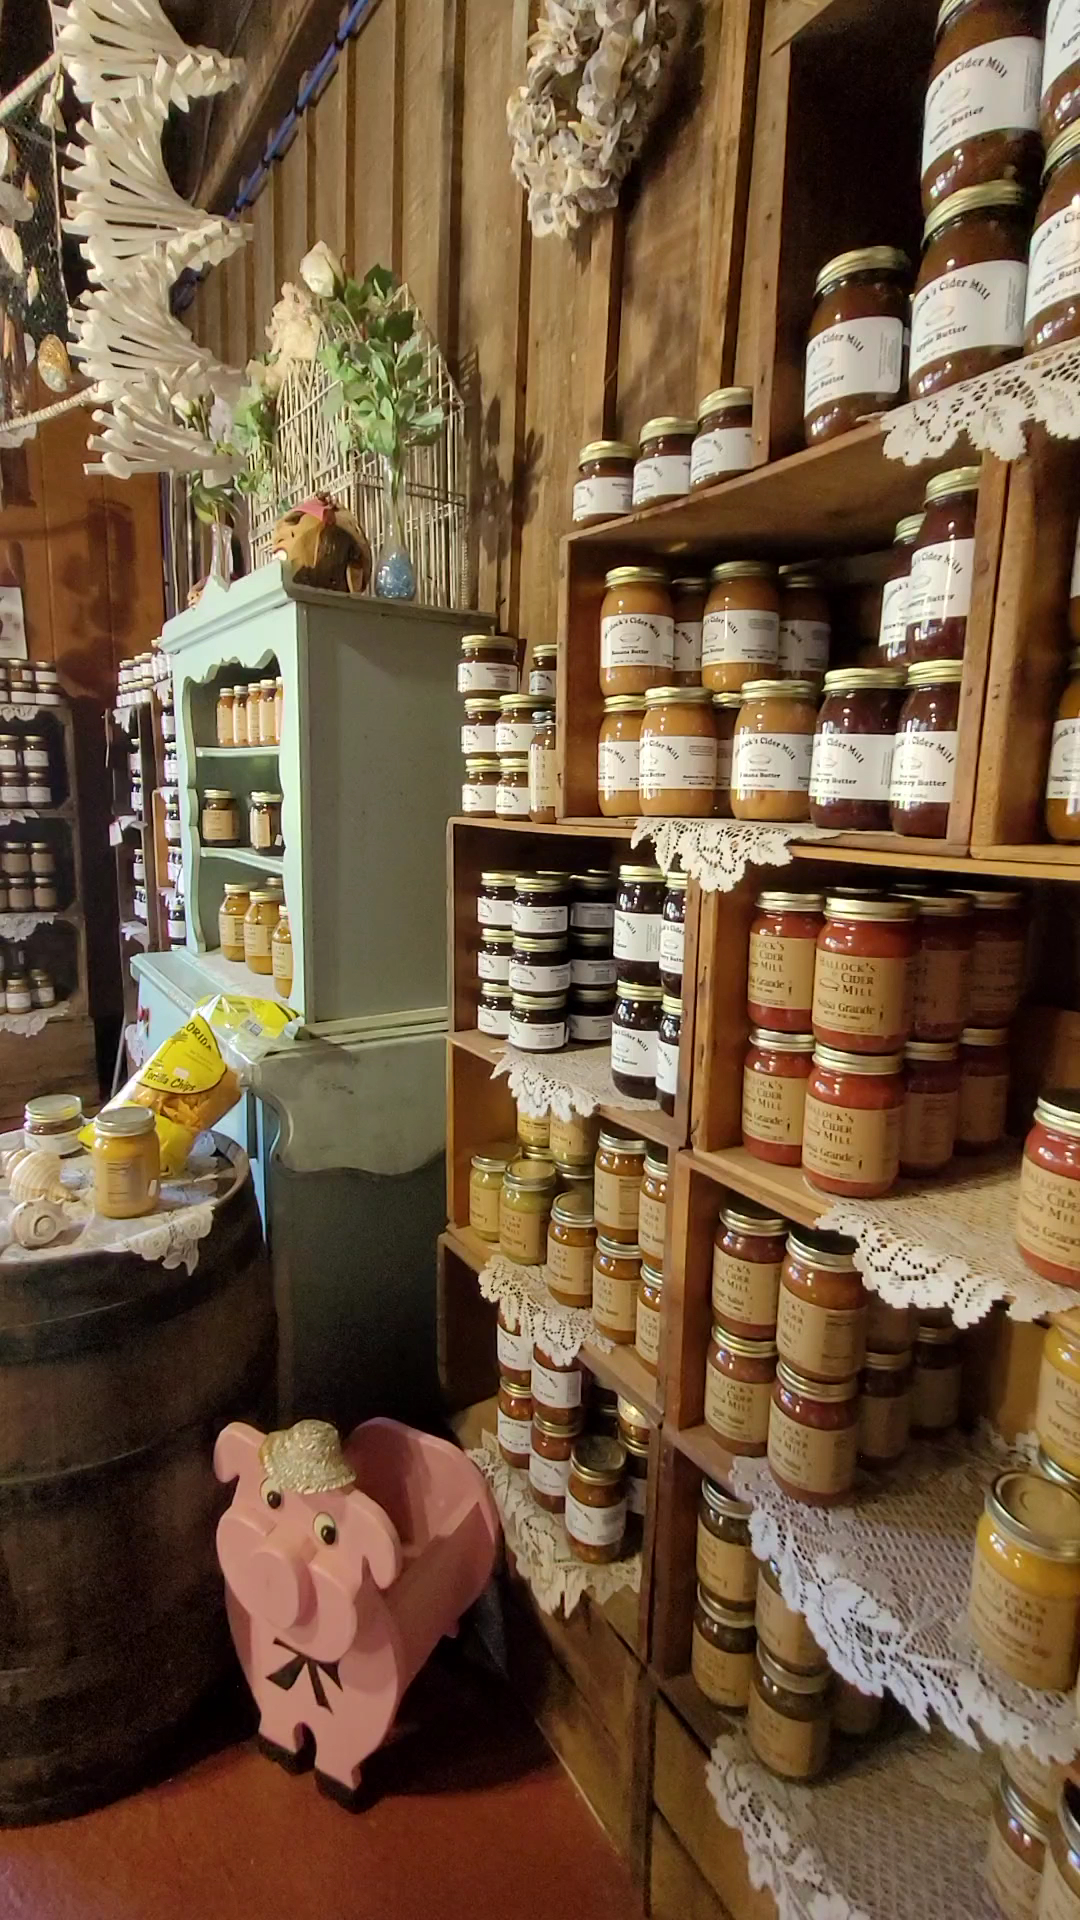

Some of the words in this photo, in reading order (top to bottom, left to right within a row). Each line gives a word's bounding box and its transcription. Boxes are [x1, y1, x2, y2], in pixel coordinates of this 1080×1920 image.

[953, 56, 984, 75] Cider
[985, 55, 1008, 79] Mill
[951, 105, 985, 126] Butter
[939, 275, 967, 292] Cider
[969, 278, 991, 301] Mill
[935, 324, 968, 341] Butter
[846, 333, 865, 353] Mill
[926, 593, 956, 603] Buttr
[629, 616, 648, 627] Cider
[665, 745, 680, 761] Mill
[760, 736, 781, 749] Cider
[781, 743, 796, 761] Mill
[826, 737, 848, 750] Cider
[848, 744, 865, 764] Mill
[912, 735, 935, 749] Cider
[936, 743, 955, 764] Mill
[917, 779, 947, 787] Butter
[759, 949, 784, 962] CIDER
[760, 960, 784, 973] MILL
[819, 956, 876, 973] HALLOCK'S
[841, 973, 874, 985] CIDER
[842, 984, 873, 997] MILL
[838, 1002, 877, 1014] Grande
[186, 1021, 213, 1052] ORIDA
[143, 1067, 170, 1086] Tortilla
[170, 1077, 197, 1093] Chips
[758, 1097, 782, 1111] MILL
[822, 1119, 852, 1135] CIDER
[824, 1130, 851, 1145] MILL
[820, 1147, 856, 1162] Grande
